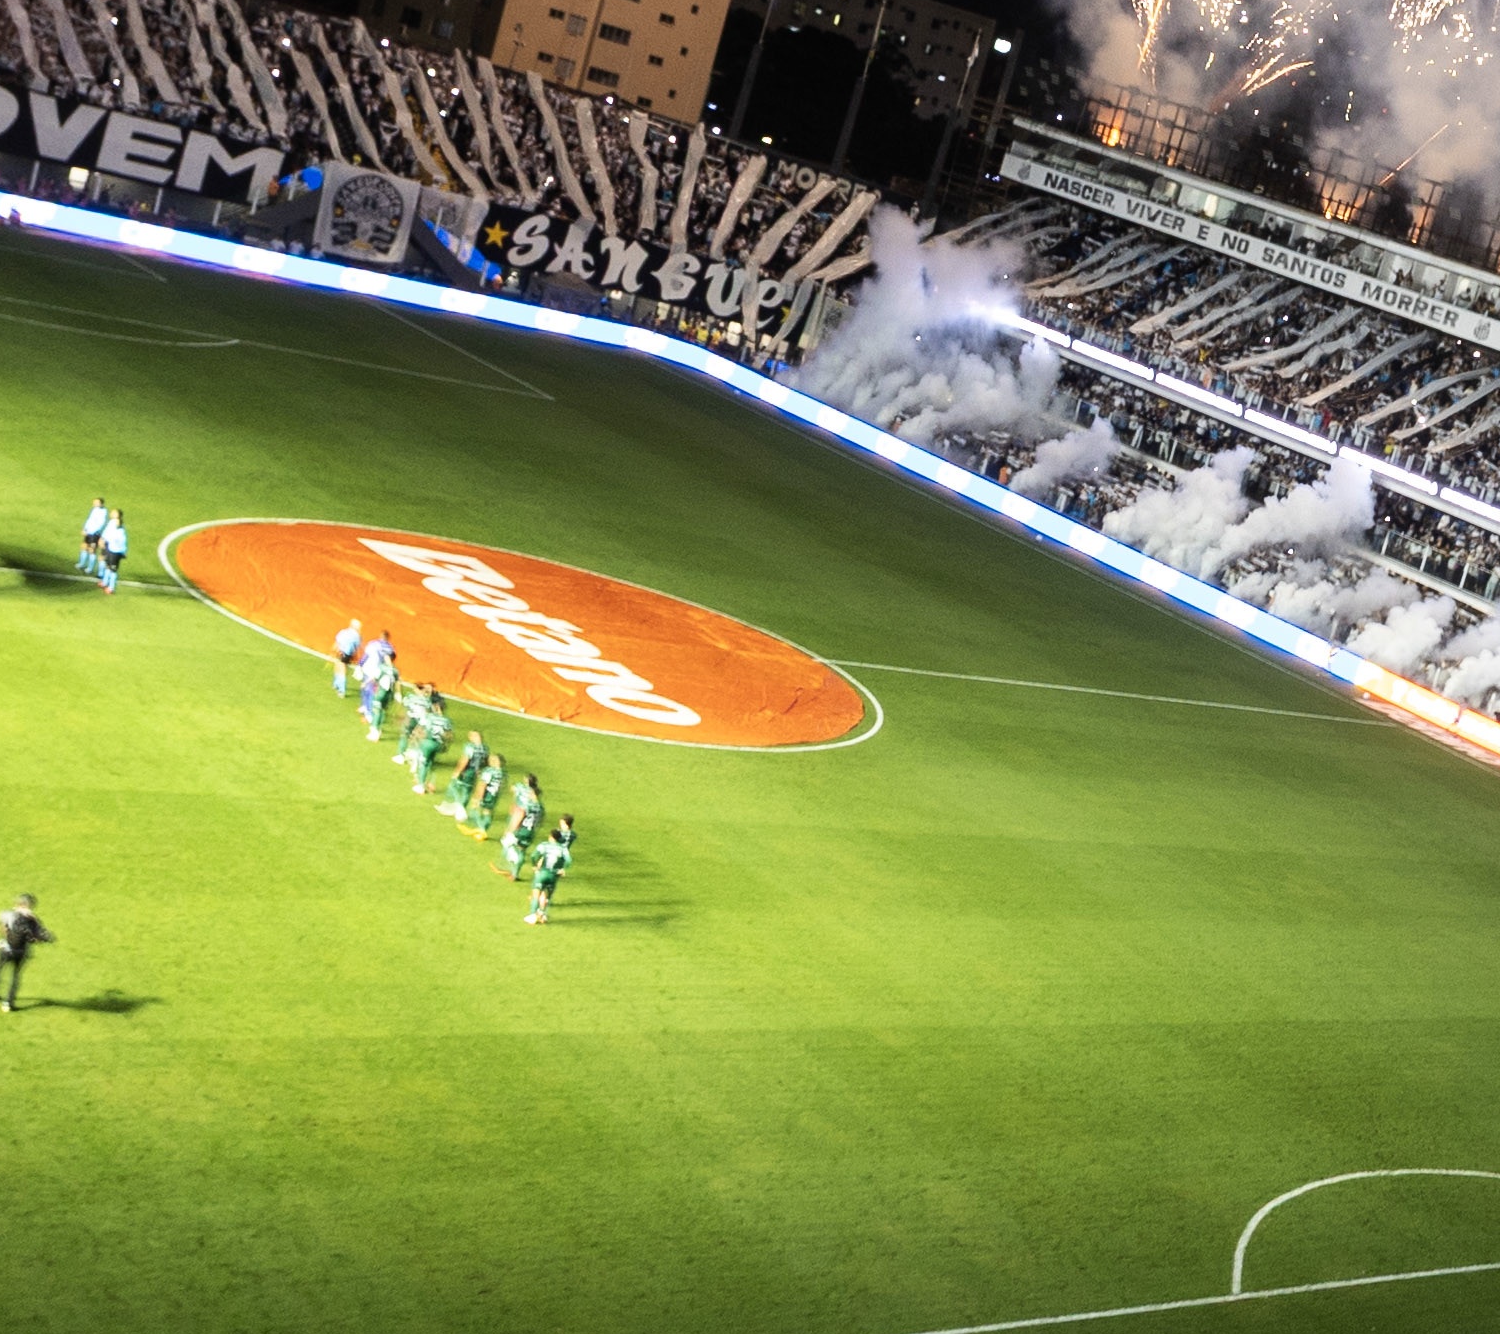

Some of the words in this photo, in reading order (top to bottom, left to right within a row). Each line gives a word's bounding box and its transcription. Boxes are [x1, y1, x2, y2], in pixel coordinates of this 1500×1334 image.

[1126, 199, 1185, 234] VIVER
[1199, 225, 1210, 240] E
[1221, 232, 1252, 255] NO
[1262, 245, 1346, 288] SANTOS
[1362, 279, 1459, 328] MORRER
[357, 537, 701, 726] Betano
